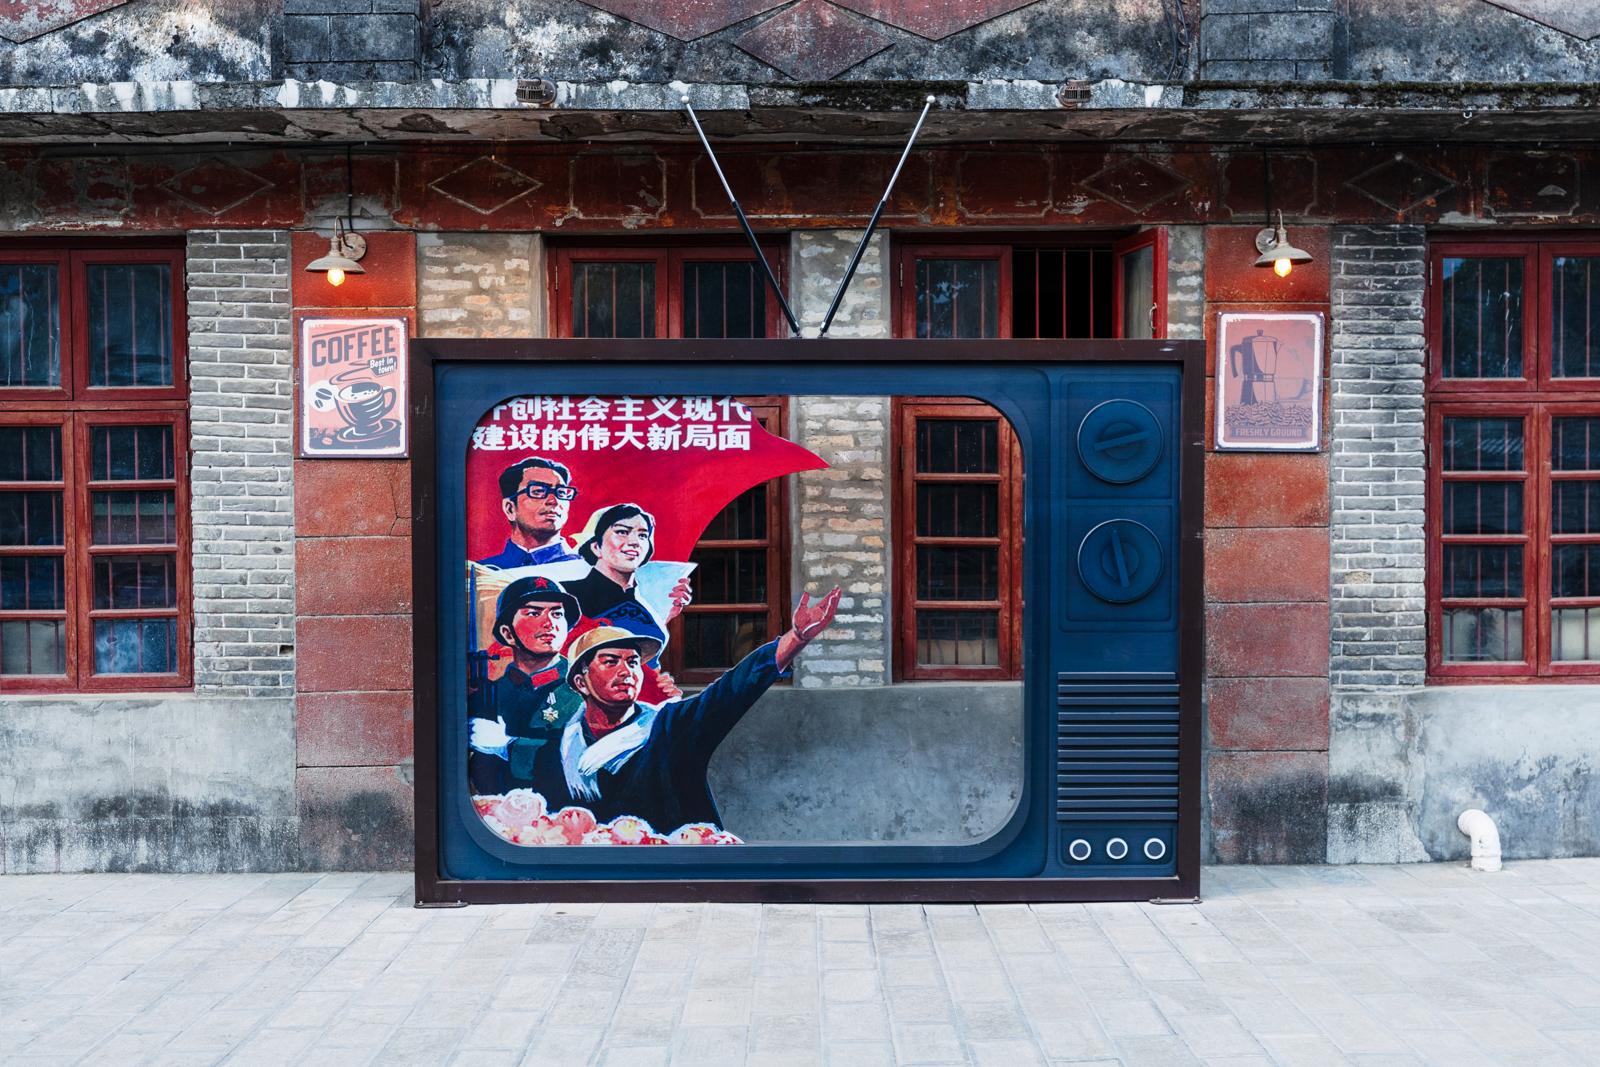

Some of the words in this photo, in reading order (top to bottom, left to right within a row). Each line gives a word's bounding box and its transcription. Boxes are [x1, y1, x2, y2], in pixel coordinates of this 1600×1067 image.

[312, 326, 395, 367] COFFEE
[370, 359, 385, 368] Best
[386, 357, 394, 365] in
[378, 361, 396, 374] town!
[472, 423, 752, 450] 建设的伟大新局面
[1236, 427, 1269, 437] FRESHLY
[1271, 427, 1302, 437] GROUND
